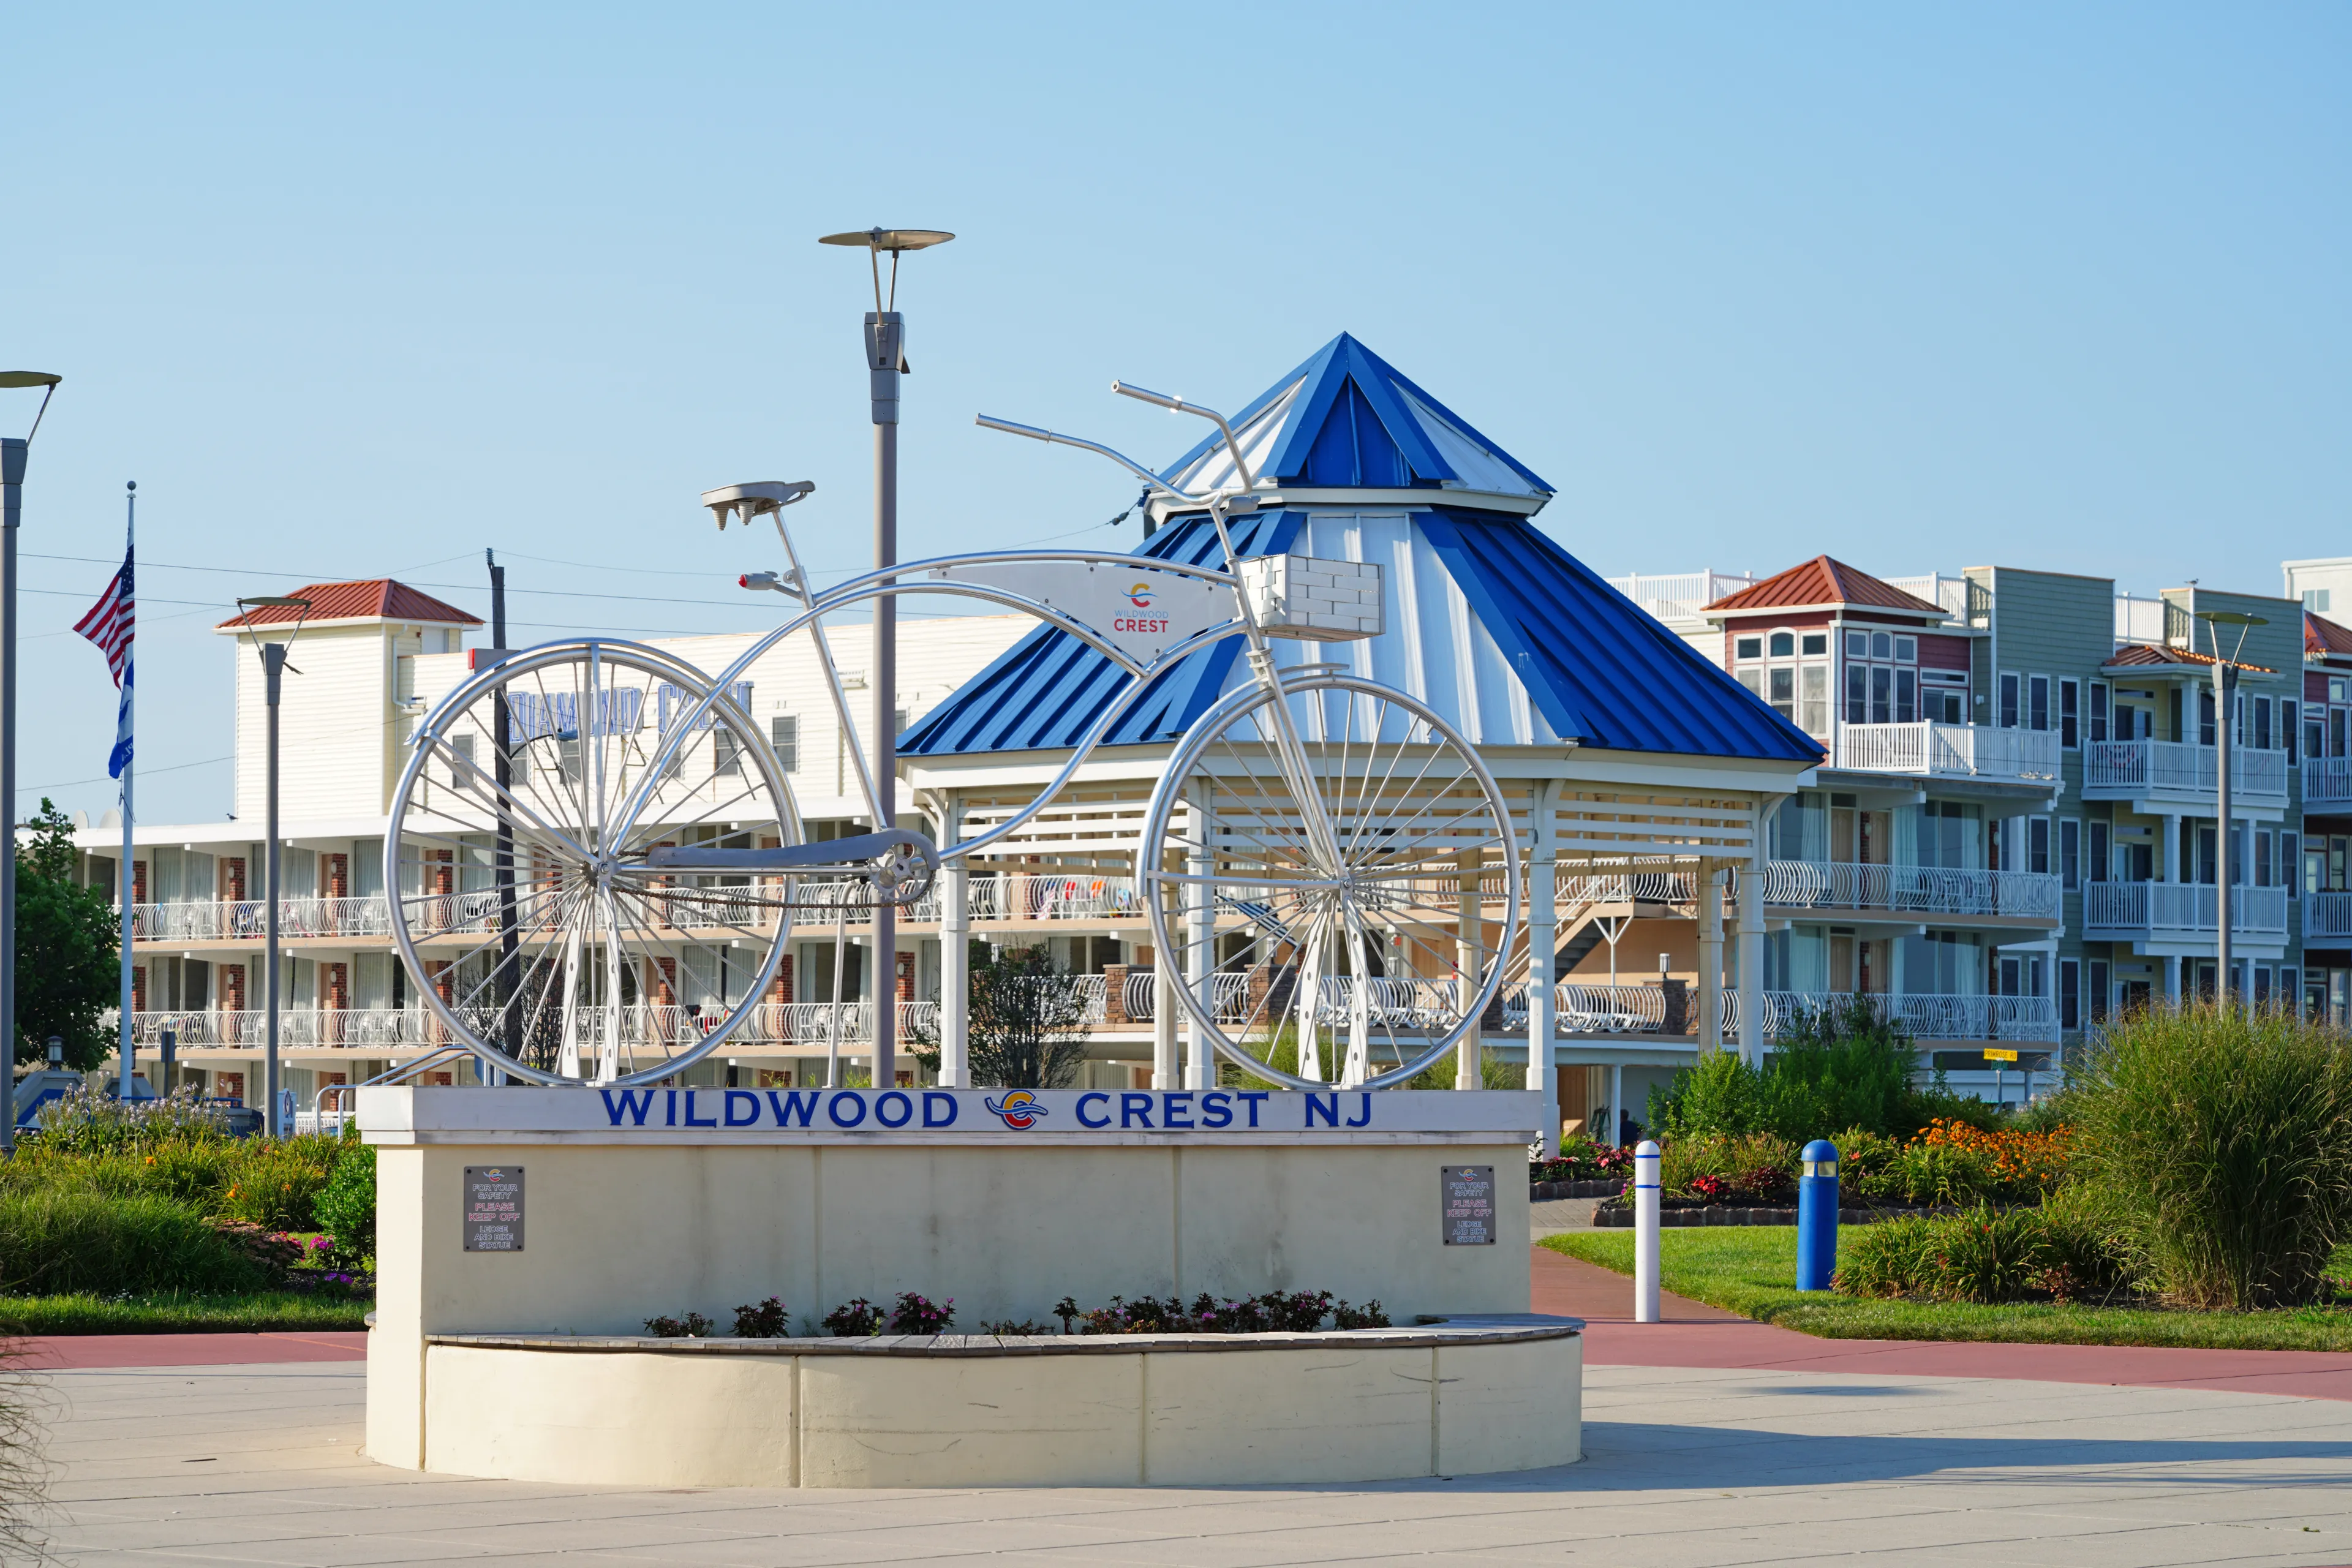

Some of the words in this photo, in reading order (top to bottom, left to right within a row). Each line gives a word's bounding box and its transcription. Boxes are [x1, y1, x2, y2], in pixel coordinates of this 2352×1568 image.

[1114, 609, 1169, 619] WILDWOOD
[1114, 619, 1169, 633] CREST
[1985, 1050, 2008, 1058] PRIMROSE
[598, 1089, 959, 1129] WILDWOOD
[1076, 1091, 1269, 1129] CREST
[1304, 1092, 1372, 1128] NJ
[475, 1202, 515, 1212] PLEASE
[1452, 1199, 1487, 1208] PLEASE
[469, 1213, 496, 1221] KEEP
[499, 1213, 521, 1221] OFF
